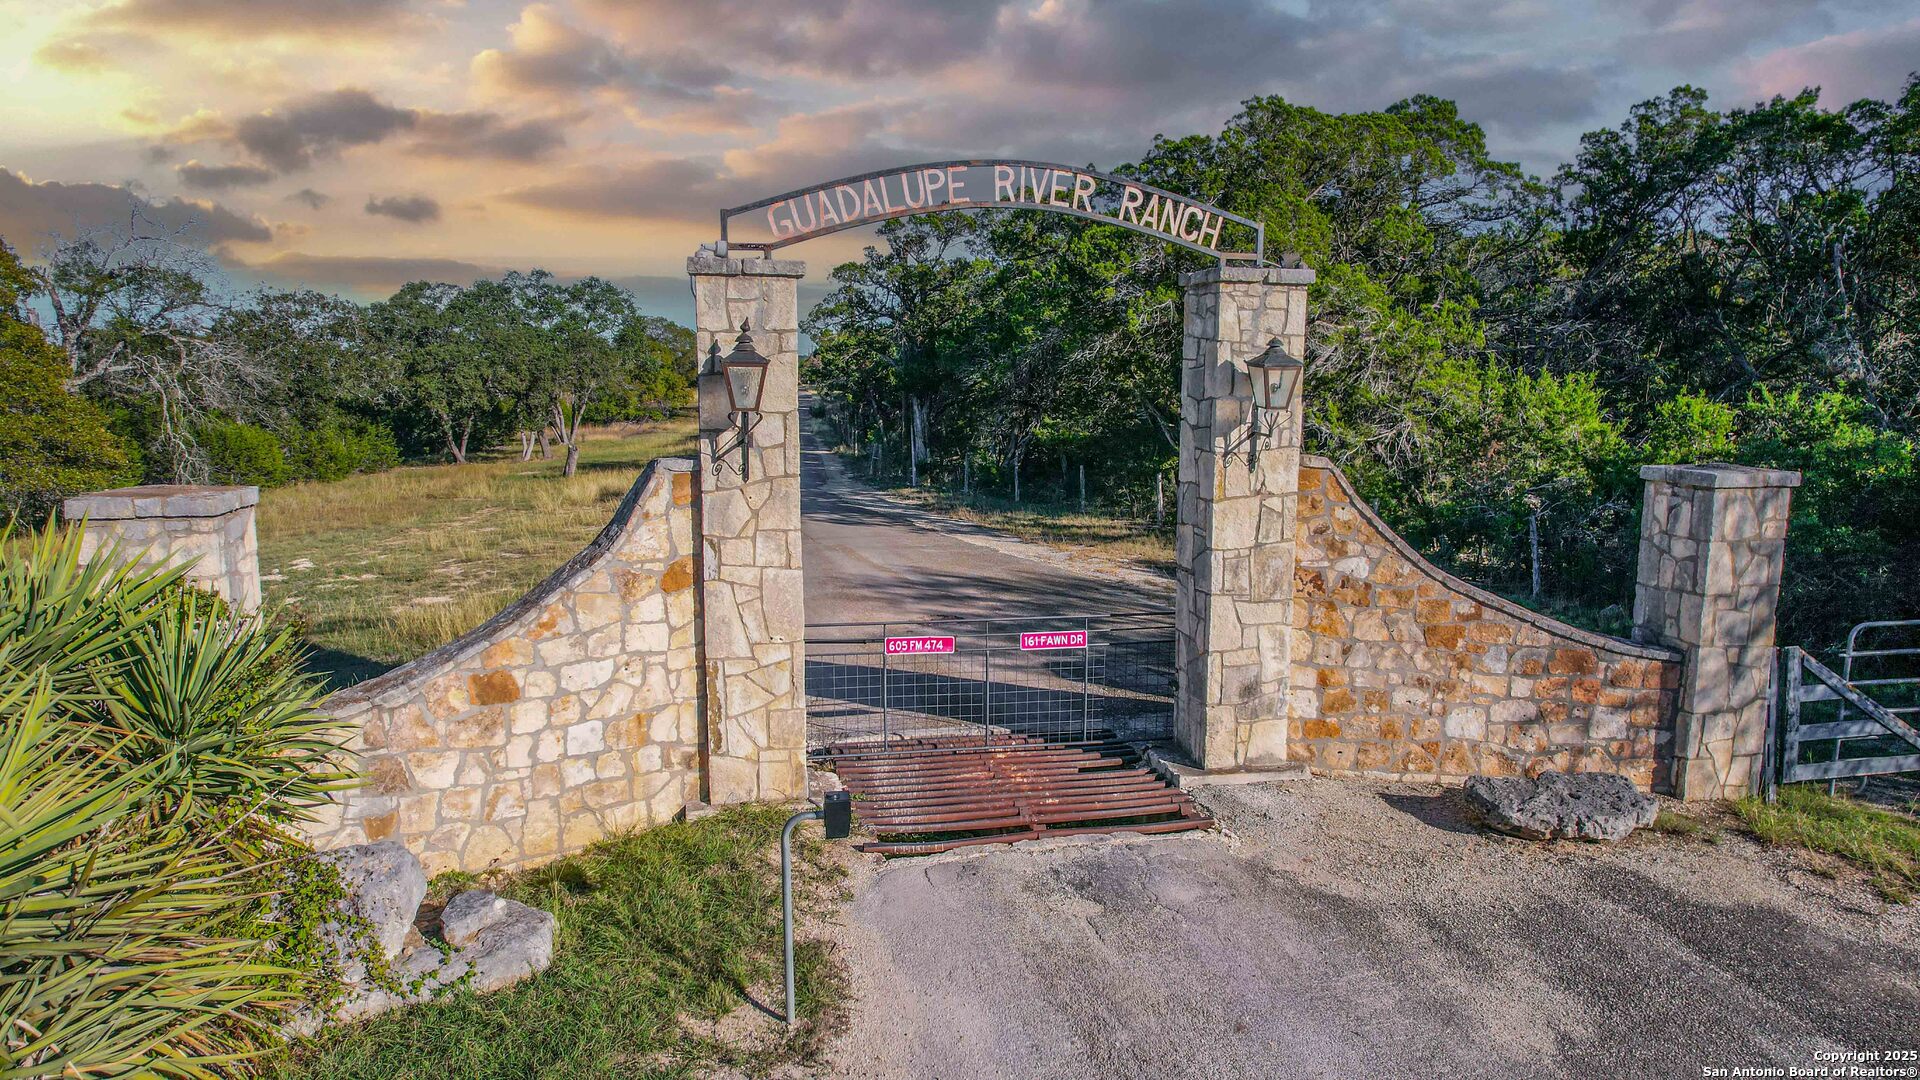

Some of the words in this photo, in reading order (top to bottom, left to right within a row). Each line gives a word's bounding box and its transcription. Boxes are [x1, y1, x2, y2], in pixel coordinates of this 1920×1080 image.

[767, 166, 970, 240] GUADALUPE
[994, 165, 1097, 213] RIVER
[1118, 185, 1225, 249] RANCH
[888, 641, 908, 651] 605
[910, 641, 923, 650] FM
[924, 640, 944, 650] 474
[1039, 635, 1068, 646] FAWN
[1070, 635, 1084, 644] DR
